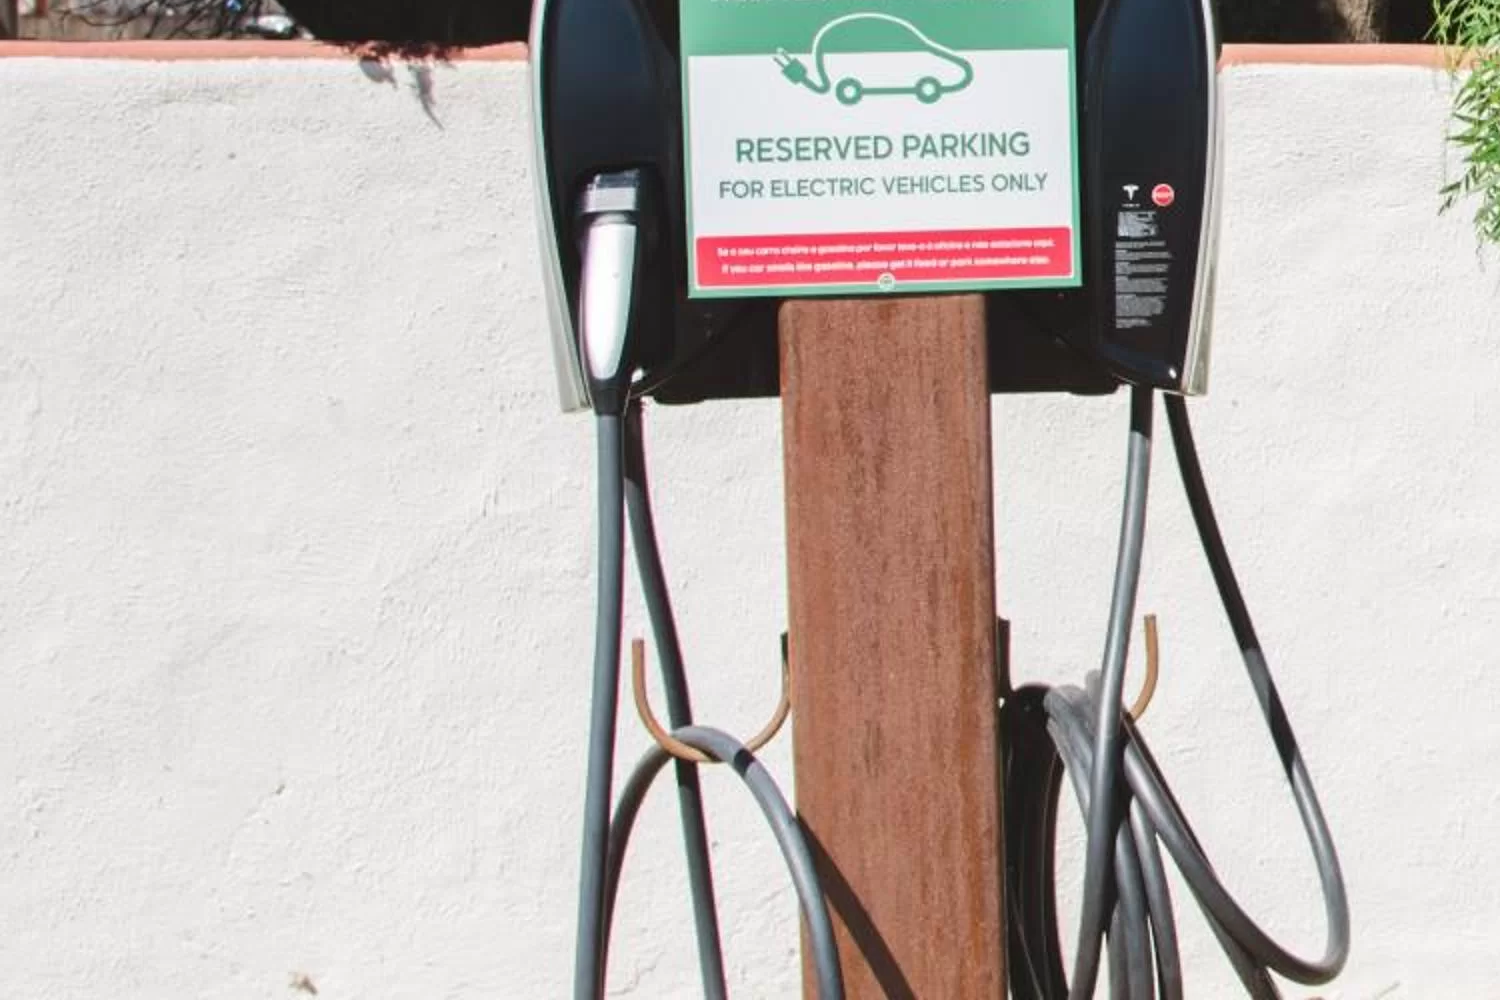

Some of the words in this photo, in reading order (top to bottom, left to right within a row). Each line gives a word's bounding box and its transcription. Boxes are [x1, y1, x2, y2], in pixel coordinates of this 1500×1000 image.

[735, 135, 893, 164] RESERVED
[902, 131, 1031, 159] PARKING
[719, 179, 765, 199] FOR
[769, 176, 876, 198] ELECTRIC
[881, 173, 985, 196] VEHICLES
[991, 171, 1049, 194] ONLY
